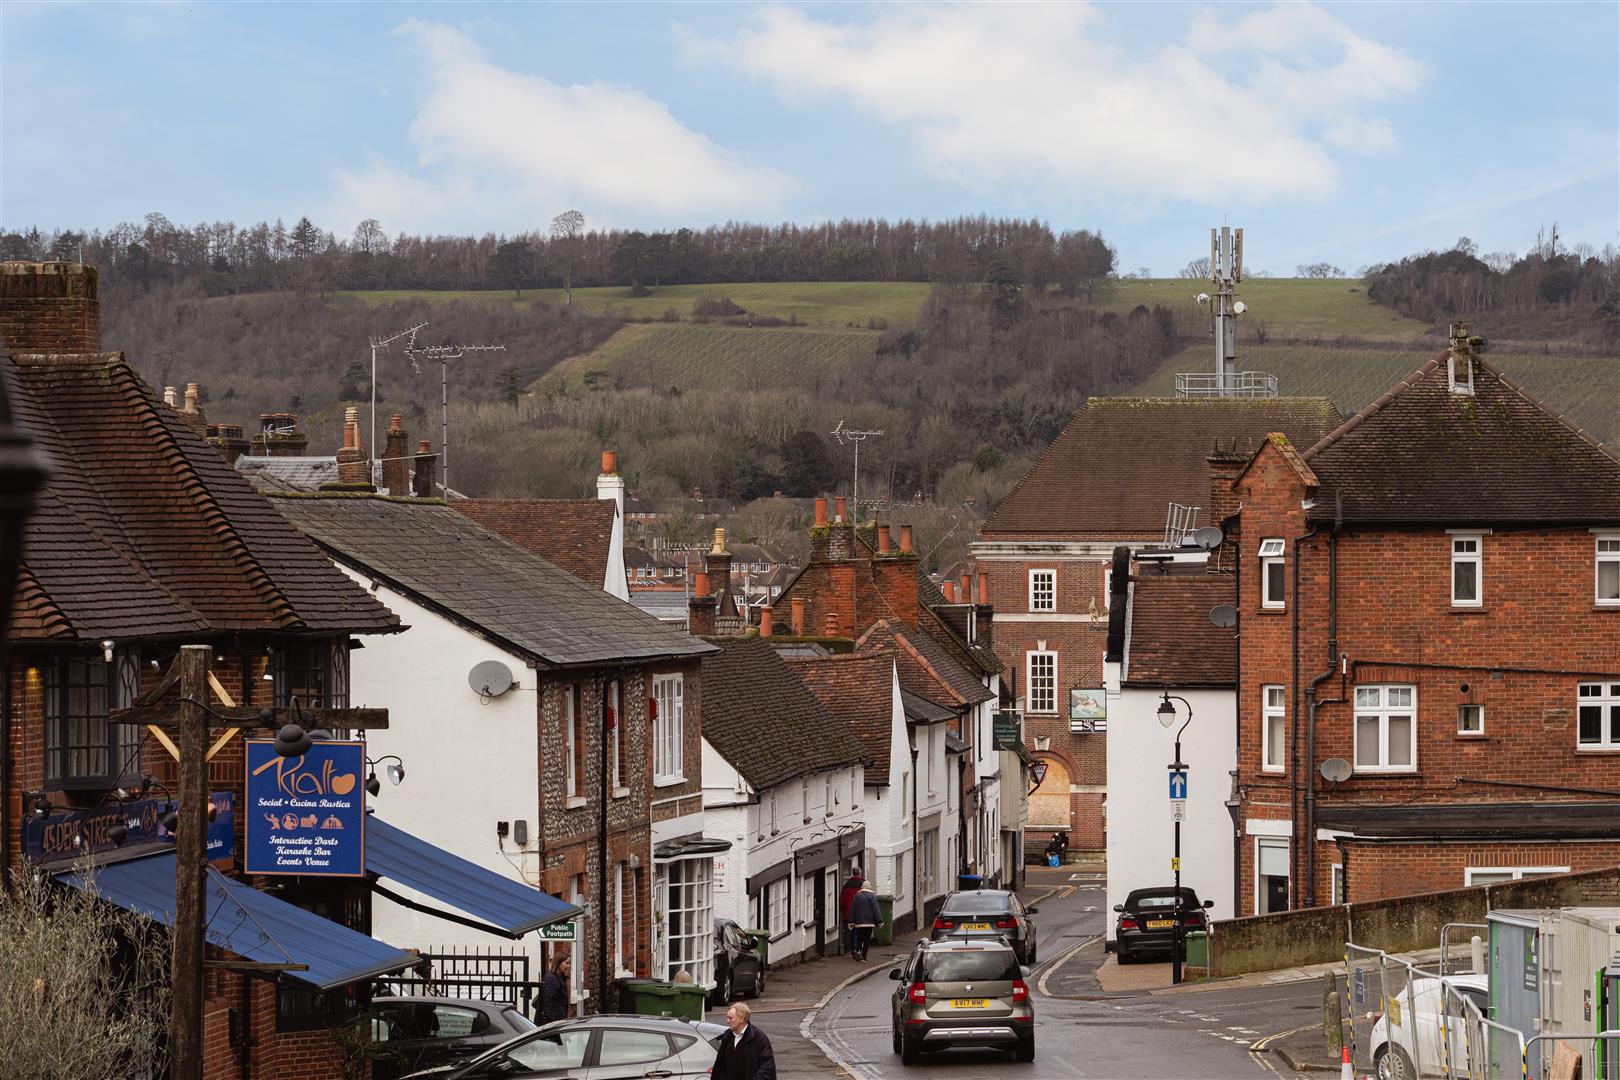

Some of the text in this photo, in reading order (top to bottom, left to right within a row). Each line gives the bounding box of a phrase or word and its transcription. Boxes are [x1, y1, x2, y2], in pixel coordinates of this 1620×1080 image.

[258, 797, 351, 808] Social Cucina Rustica
[269, 835, 339, 846] Interactive Darts
[275, 846, 332, 856] Karaoke Bar
[276, 856, 330, 867] Events Venue
